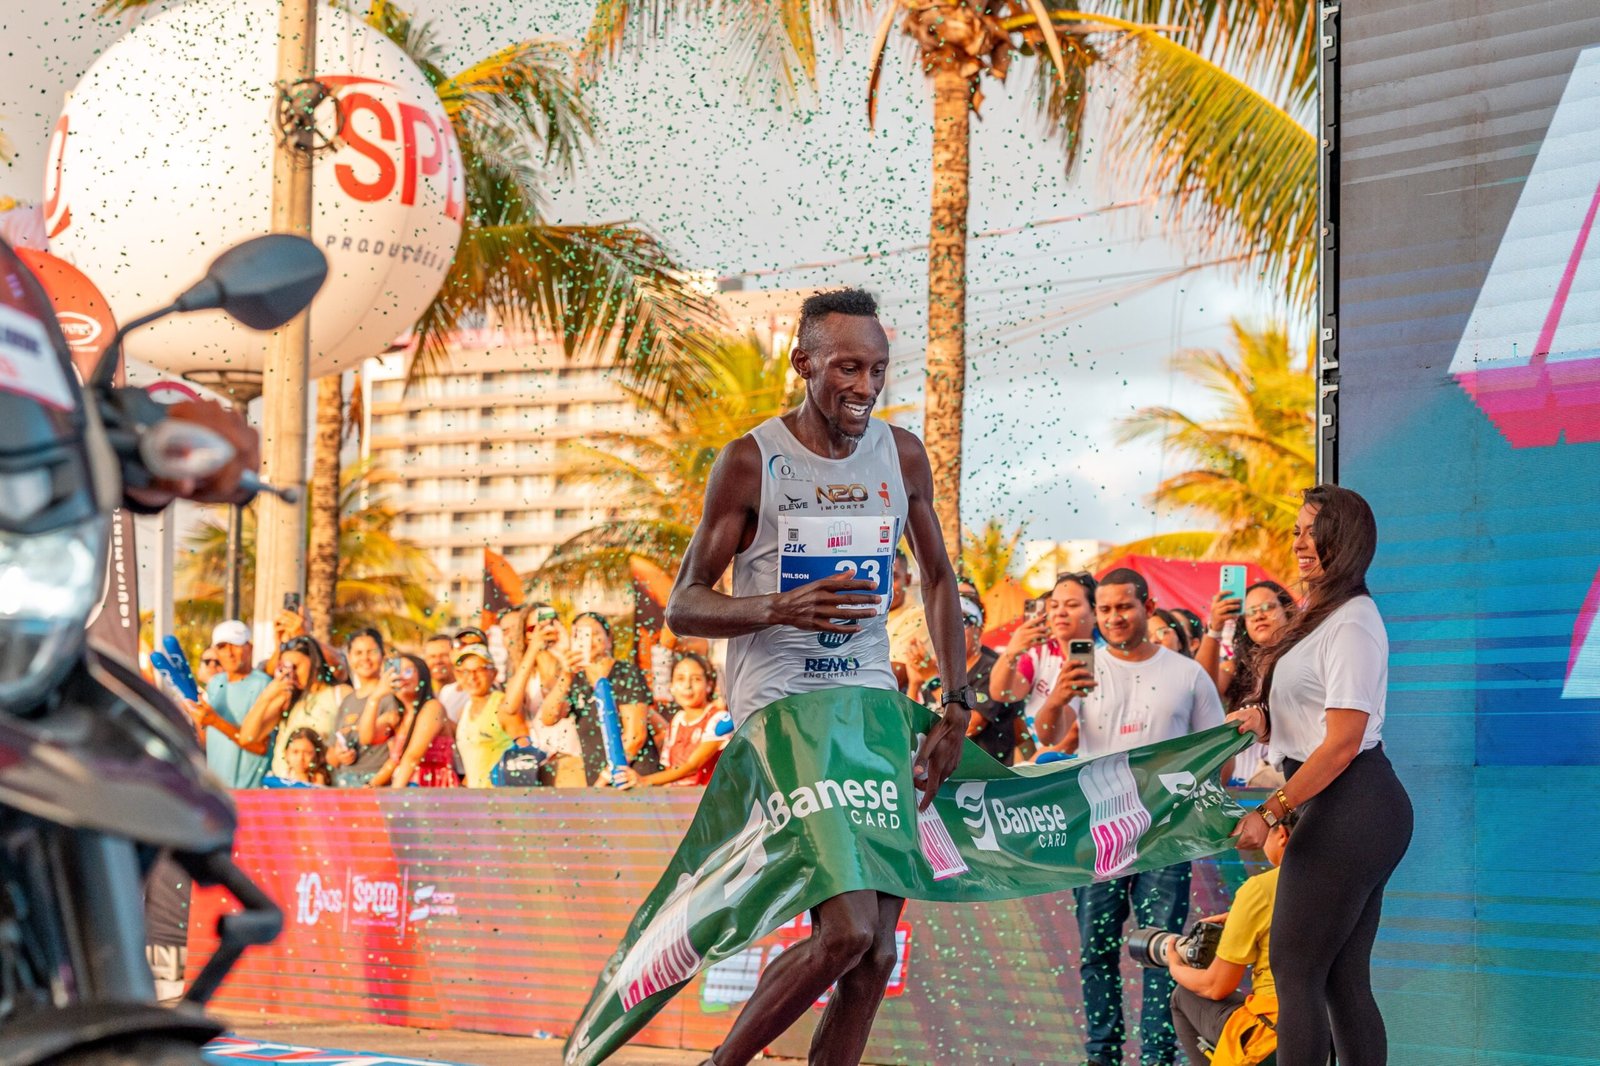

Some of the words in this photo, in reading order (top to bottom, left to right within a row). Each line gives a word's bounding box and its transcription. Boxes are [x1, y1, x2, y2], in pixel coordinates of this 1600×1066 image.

[778, 501, 809, 512] ELEWE
[820, 503, 865, 511] IMPORTS
[783, 543, 807, 553] 21K
[781, 572, 810, 580] WILSON
[803, 671, 858, 679] ENGENHARIA
[766, 777, 899, 834] Banese
[850, 809, 900, 829] CARD
[992, 798, 1067, 835] Banese
[1039, 832, 1067, 848] CARD
